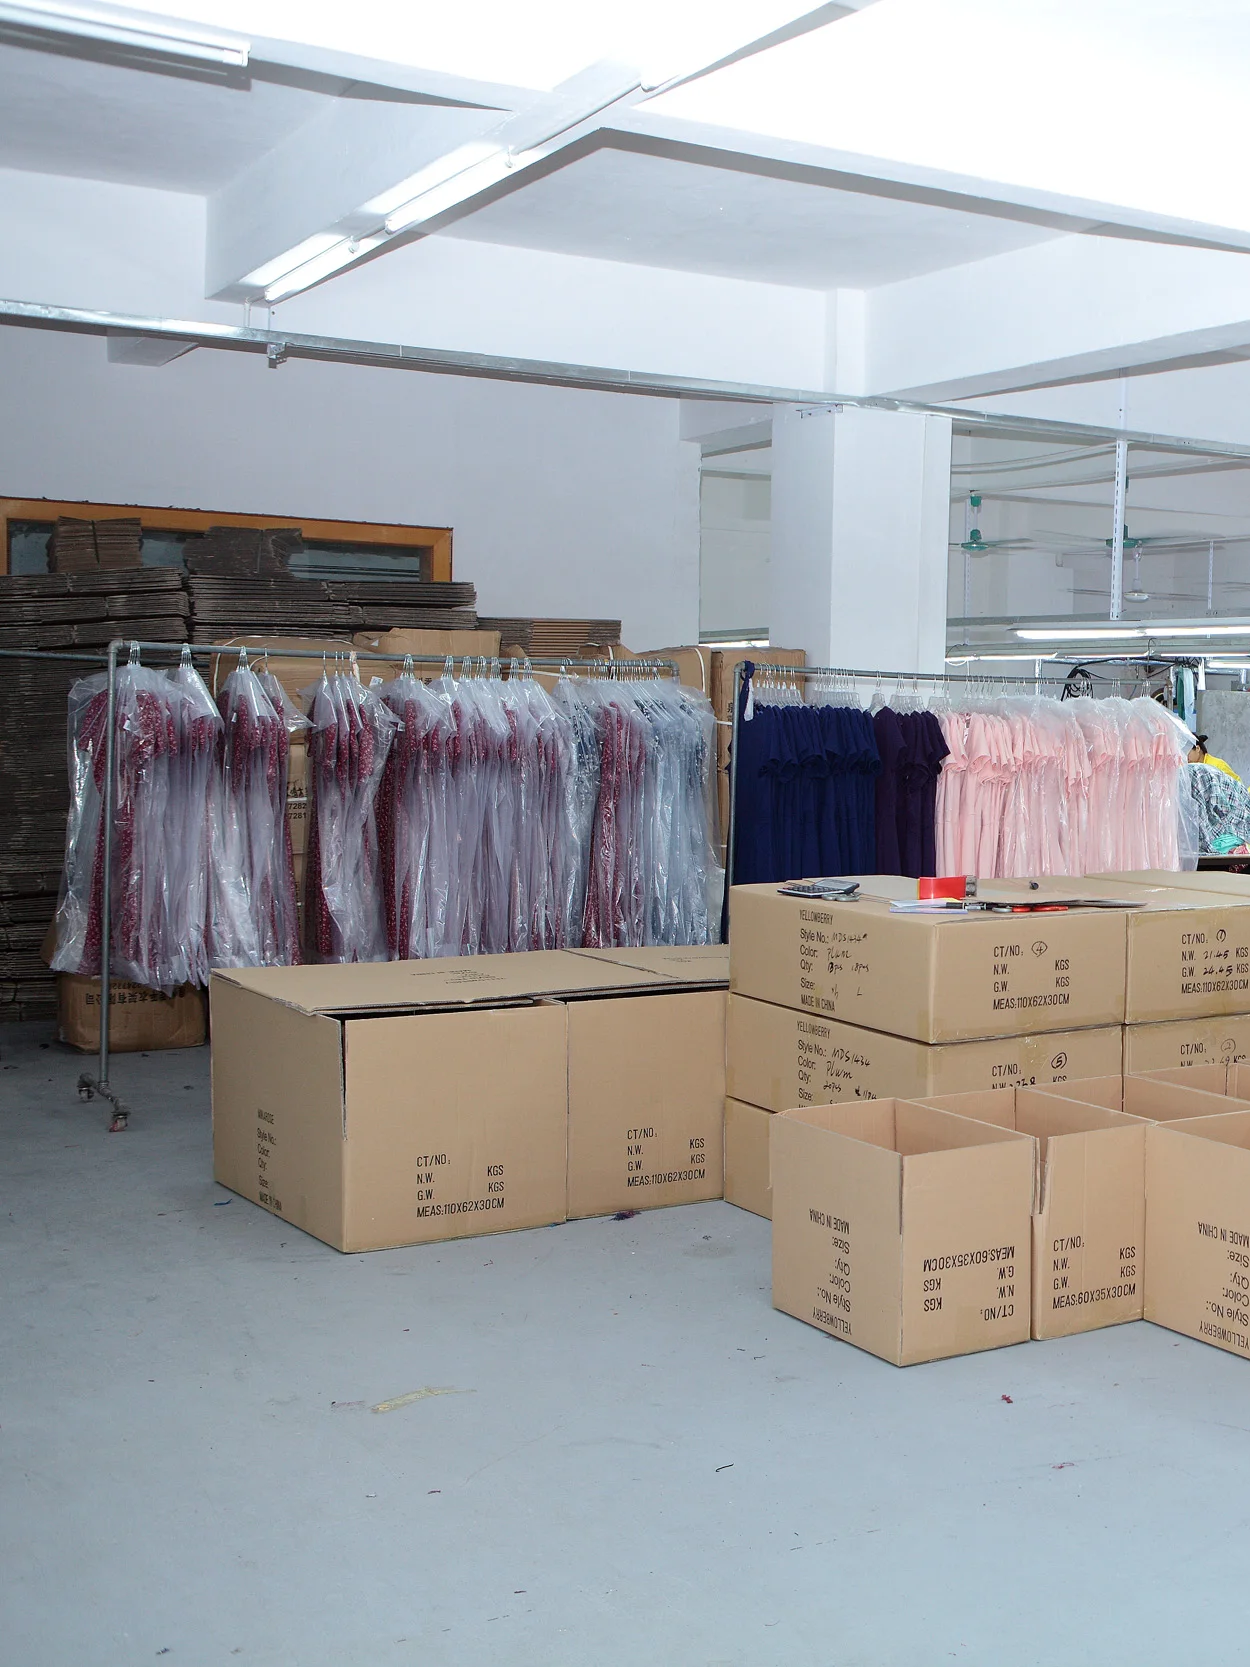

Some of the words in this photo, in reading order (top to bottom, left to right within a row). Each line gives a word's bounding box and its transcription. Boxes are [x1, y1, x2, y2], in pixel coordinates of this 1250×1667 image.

[800, 910, 833, 925] YELLOWBERRY
[800, 928, 814, 942] Style
[816, 932, 829, 944] No.:
[1182, 934, 1208, 944] CT/NO:
[800, 944, 818, 958] Color:
[994, 945, 1024, 958] CT/NO:
[1182, 951, 1196, 961] N.W.
[1236, 946, 1248, 958] KGS
[800, 959, 813, 972] Qty:
[994, 964, 1009, 975] N.W.
[1055, 960, 1070, 971] KGS
[1182, 966, 1196, 978] G.W.
[1236, 963, 1249, 974] KGS
[800, 978, 815, 990] Size:
[994, 982, 1009, 992] G.W.
[1056, 977, 1070, 988] KGS
[801, 994, 814, 1007] MADE
[816, 998, 820, 1008] IN
[822, 999, 835, 1012] CHINA
[993, 994, 1070, 1010] MEAS:110X62X30CM
[797, 1020, 830, 1039] YELLOWBERRY
[798, 1040, 813, 1054] Style
[814, 1044, 826, 1057] No.:
[1180, 1043, 1206, 1054] CT/NO:
[798, 1056, 816, 1070] Color:
[992, 1064, 1021, 1076] CT/NO:
[798, 1070, 811, 1084] Qty:
[798, 1088, 813, 1100] Size:
[627, 1128, 658, 1140] CT/NO:
[627, 1145, 644, 1156] N.W.
[690, 1138, 704, 1149] KGS
[416, 1154, 450, 1167] CT/NO:
[628, 1160, 643, 1172] G.W.
[690, 1154, 705, 1164] KGS
[416, 1172, 434, 1184] N.W.
[487, 1165, 504, 1177] KGS
[417, 1190, 434, 1201] G.W.
[488, 1182, 504, 1193] KGS
[809, 1208, 824, 1226] CHINA
[826, 1214, 832, 1228] IN
[834, 1218, 850, 1234] MADE
[1198, 1221, 1218, 1239] CHINA
[1220, 1228, 1226, 1242] IN
[1230, 1230, 1250, 1248] MADE
[832, 1236, 850, 1254] Size:
[1053, 1236, 1085, 1252] CT/NO:
[835, 1258, 850, 1276] Qty:
[1053, 1258, 1070, 1272] N.W.
[1119, 1246, 1136, 1260] KGS
[1228, 1250, 1250, 1268] Size:
[998, 1265, 1014, 1280] G.W.
[1053, 1276, 1070, 1290] G.W.
[1120, 1266, 1136, 1279] KGS
[830, 1274, 850, 1293] Color:
[924, 1278, 942, 1292] KGS
[1230, 1272, 1250, 1290] Qty:
[818, 1286, 832, 1304] No.:
[997, 1284, 1014, 1299] N.W.
[1222, 1288, 1250, 1307] Color:
[833, 1294, 850, 1312] Style
[924, 1297, 942, 1312] KGS
[1206, 1300, 1224, 1318] No.:
[812, 1306, 852, 1336] YELLOWBERRY
[980, 1304, 1014, 1322] CT/NO:
[1226, 1308, 1249, 1326] Style
[1199, 1320, 1250, 1350] YELLOWBERRY
